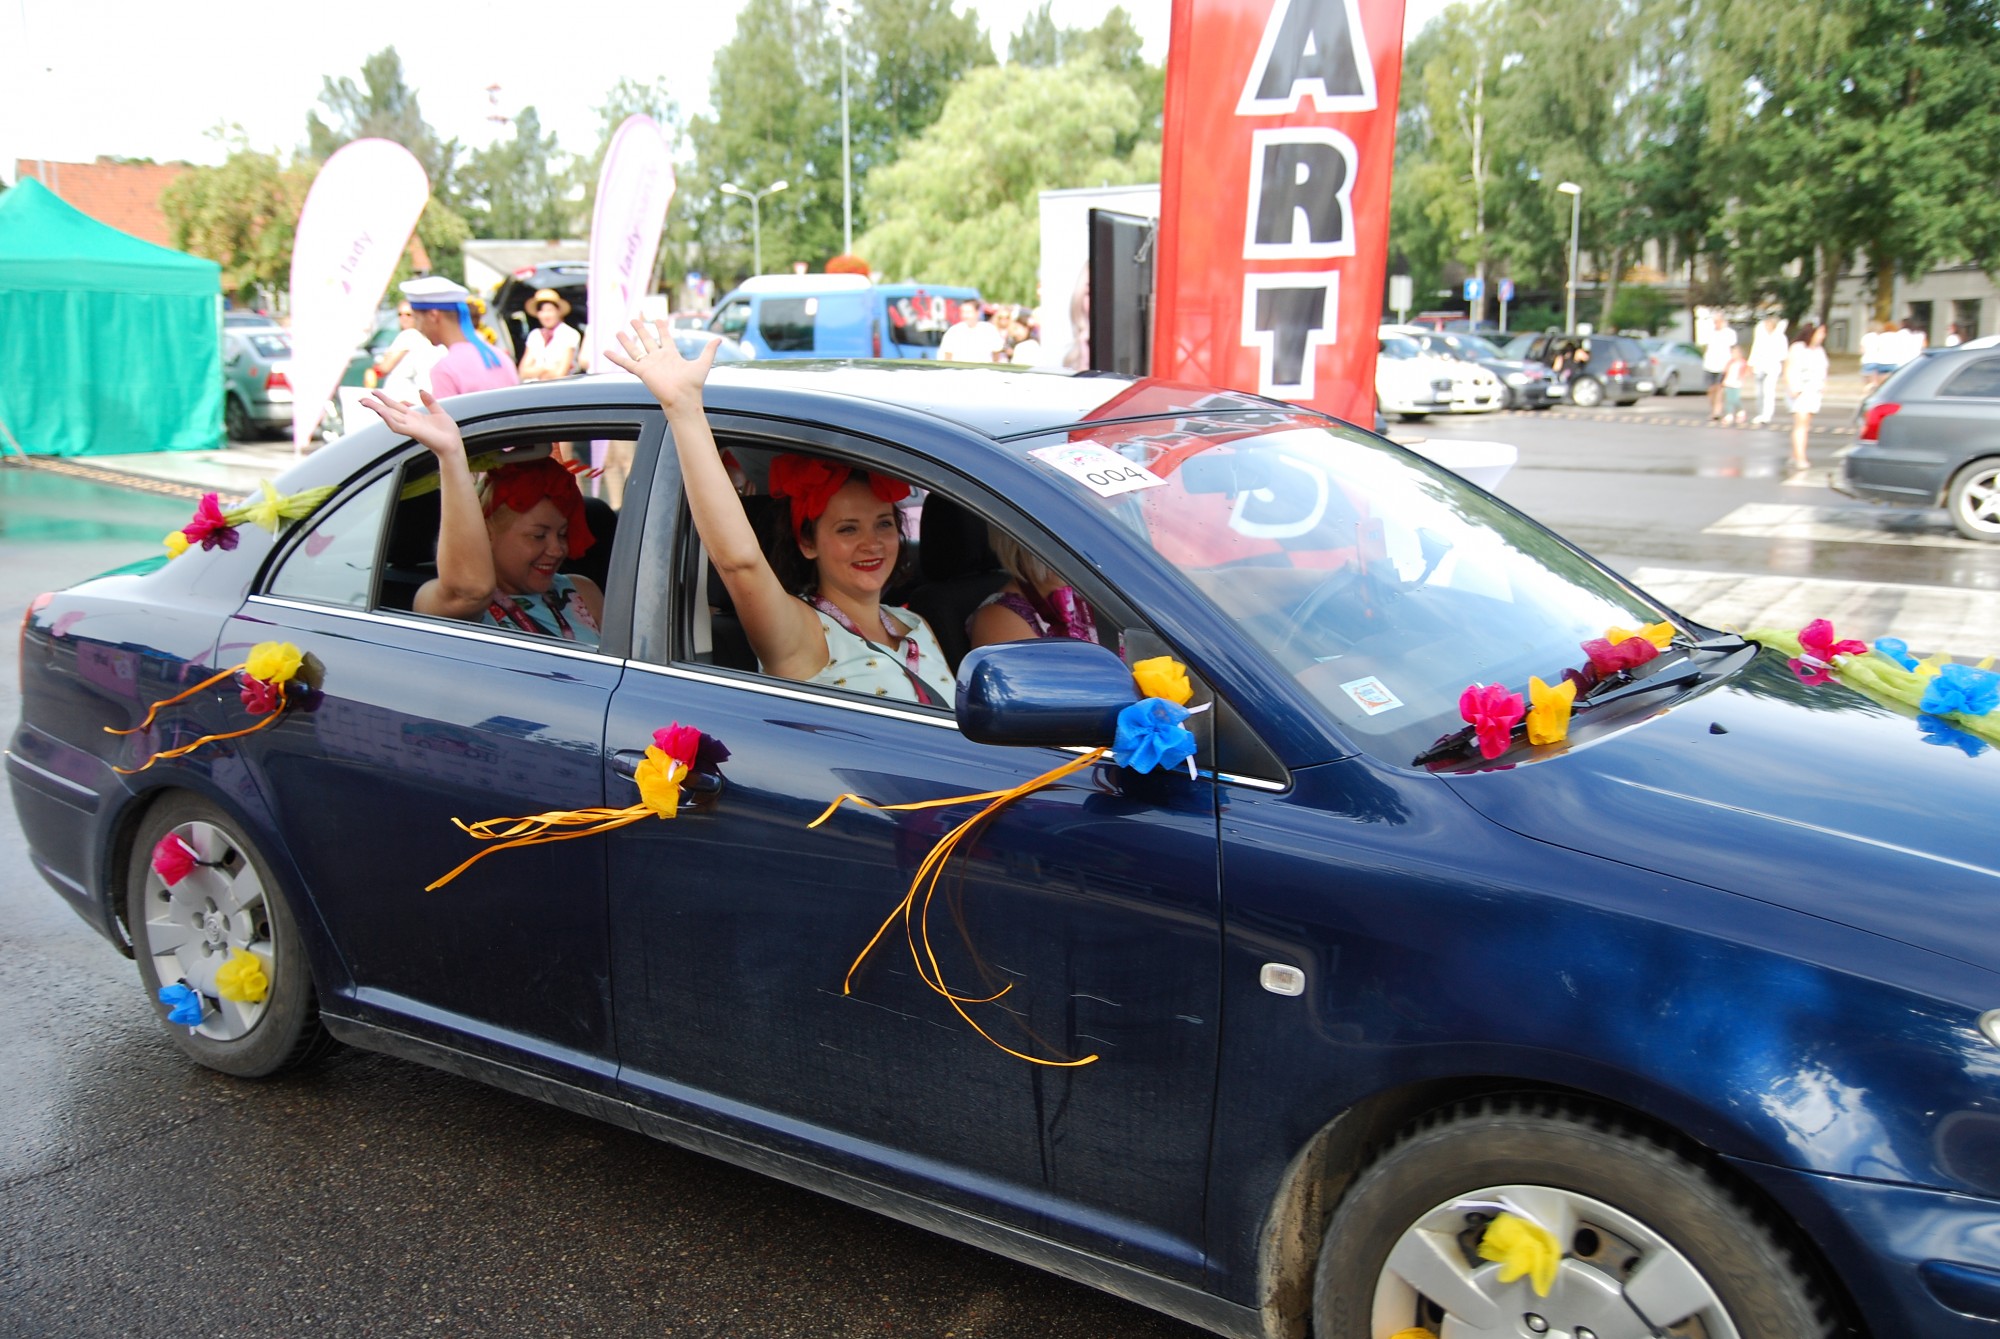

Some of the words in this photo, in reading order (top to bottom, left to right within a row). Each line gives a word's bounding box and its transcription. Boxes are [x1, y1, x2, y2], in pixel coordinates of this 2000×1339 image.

[340, 230, 374, 274] lady
[619, 224, 643, 278] lady
[1086, 466, 1148, 486] 004
